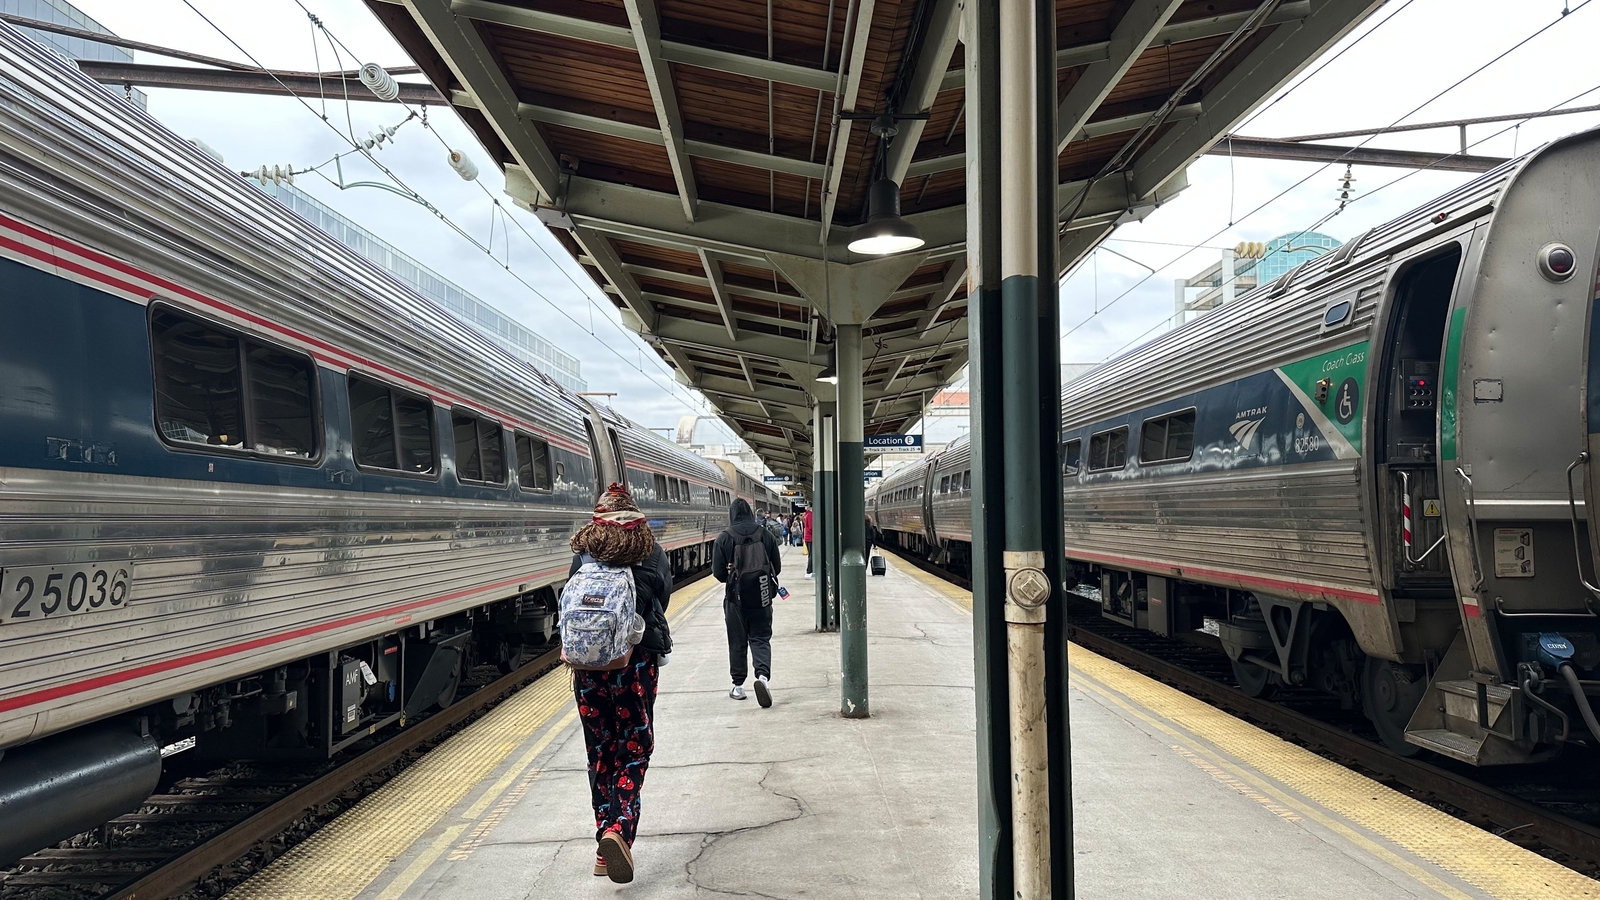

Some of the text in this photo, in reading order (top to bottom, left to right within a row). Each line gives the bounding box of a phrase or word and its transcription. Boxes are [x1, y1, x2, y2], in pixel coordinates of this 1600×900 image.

[1322, 355, 1344, 372] Coach
[1235, 406, 1268, 420] AMTRAK
[868, 437, 903, 445] Location
[1295, 435, 1320, 453] 82580
[11, 568, 129, 618] 25036
[759, 574, 770, 608] arena
[345, 669, 359, 687] AMF
